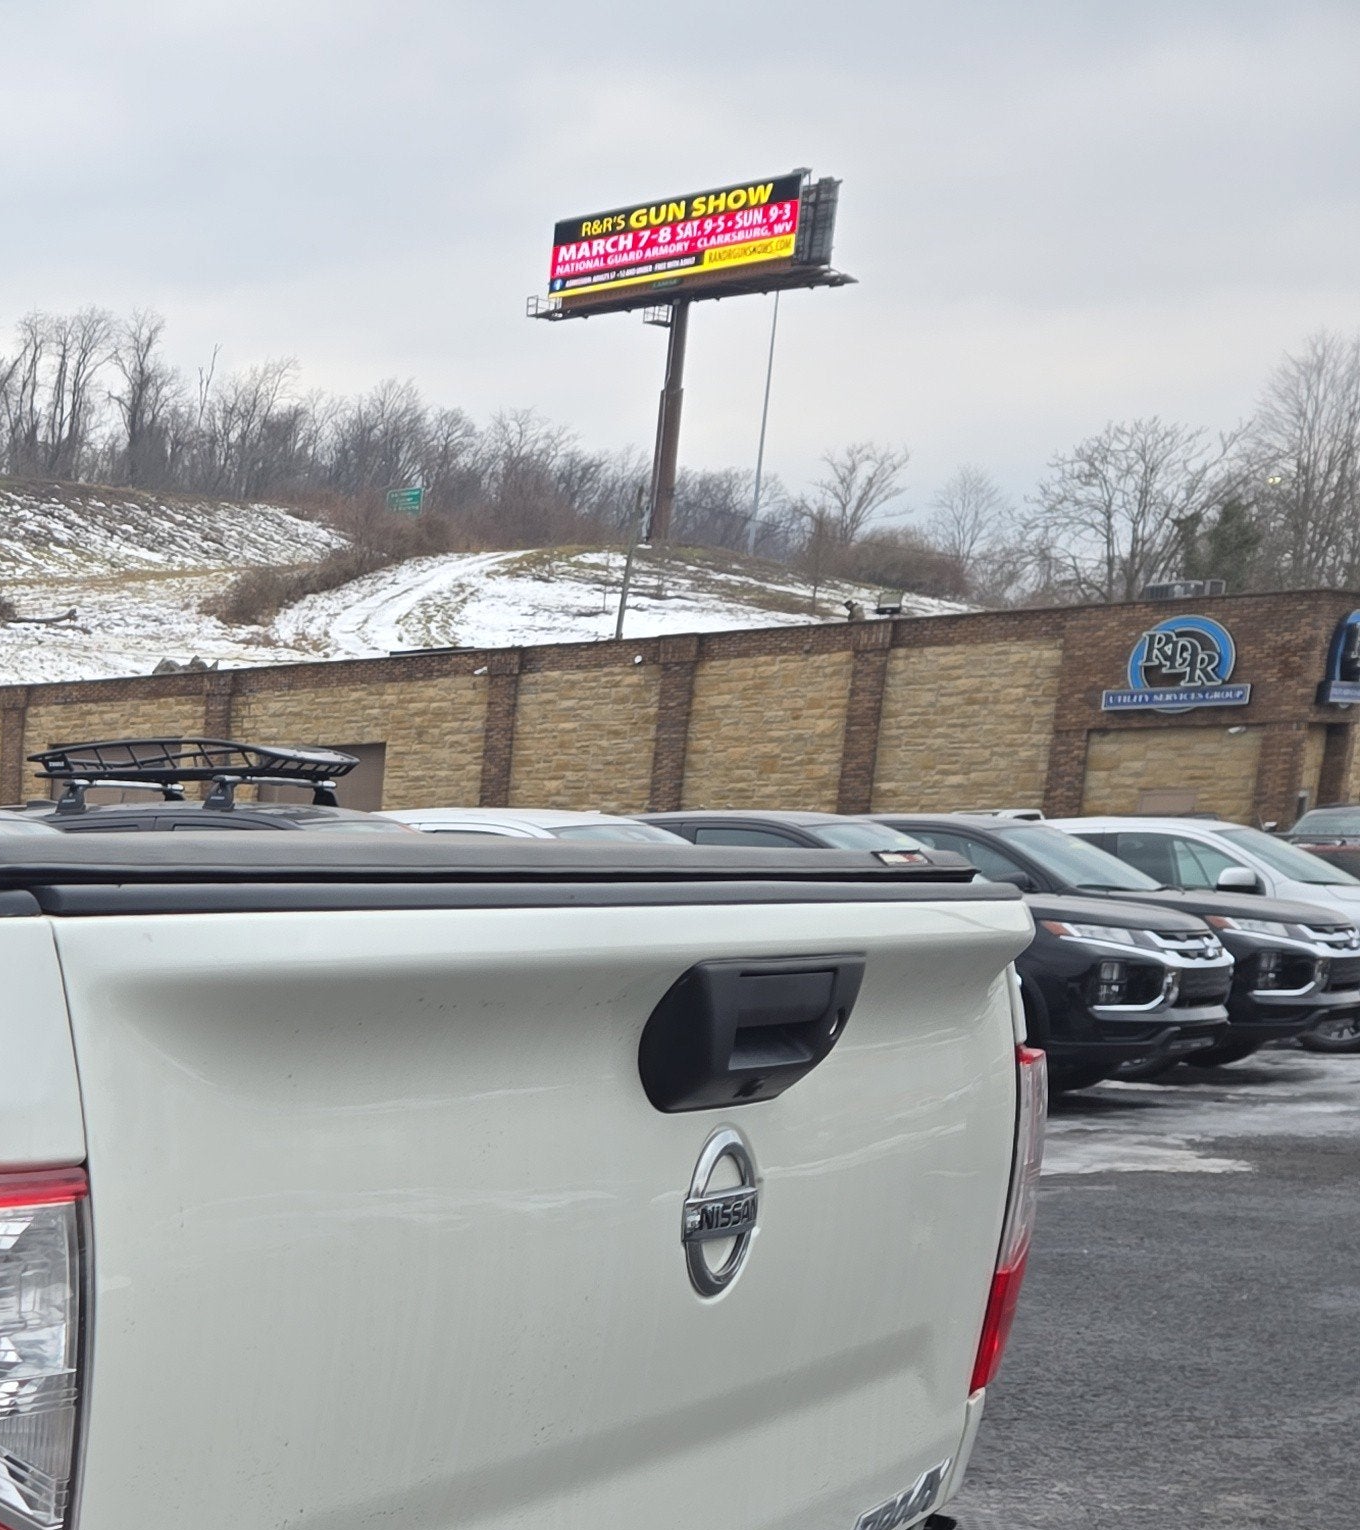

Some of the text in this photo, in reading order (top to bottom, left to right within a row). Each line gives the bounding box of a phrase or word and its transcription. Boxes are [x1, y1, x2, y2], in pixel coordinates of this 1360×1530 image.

[557, 203, 792, 263] MARCH 7-8 SAT. 9-5 SUN. 9-3
[581, 183, 774, 237] R&R'S GUN SHOW
[555, 220, 793, 276] NATIONAL GUARD ARMORY CLARKSBURG, WV
[698, 1197, 758, 1231] NISSAN
